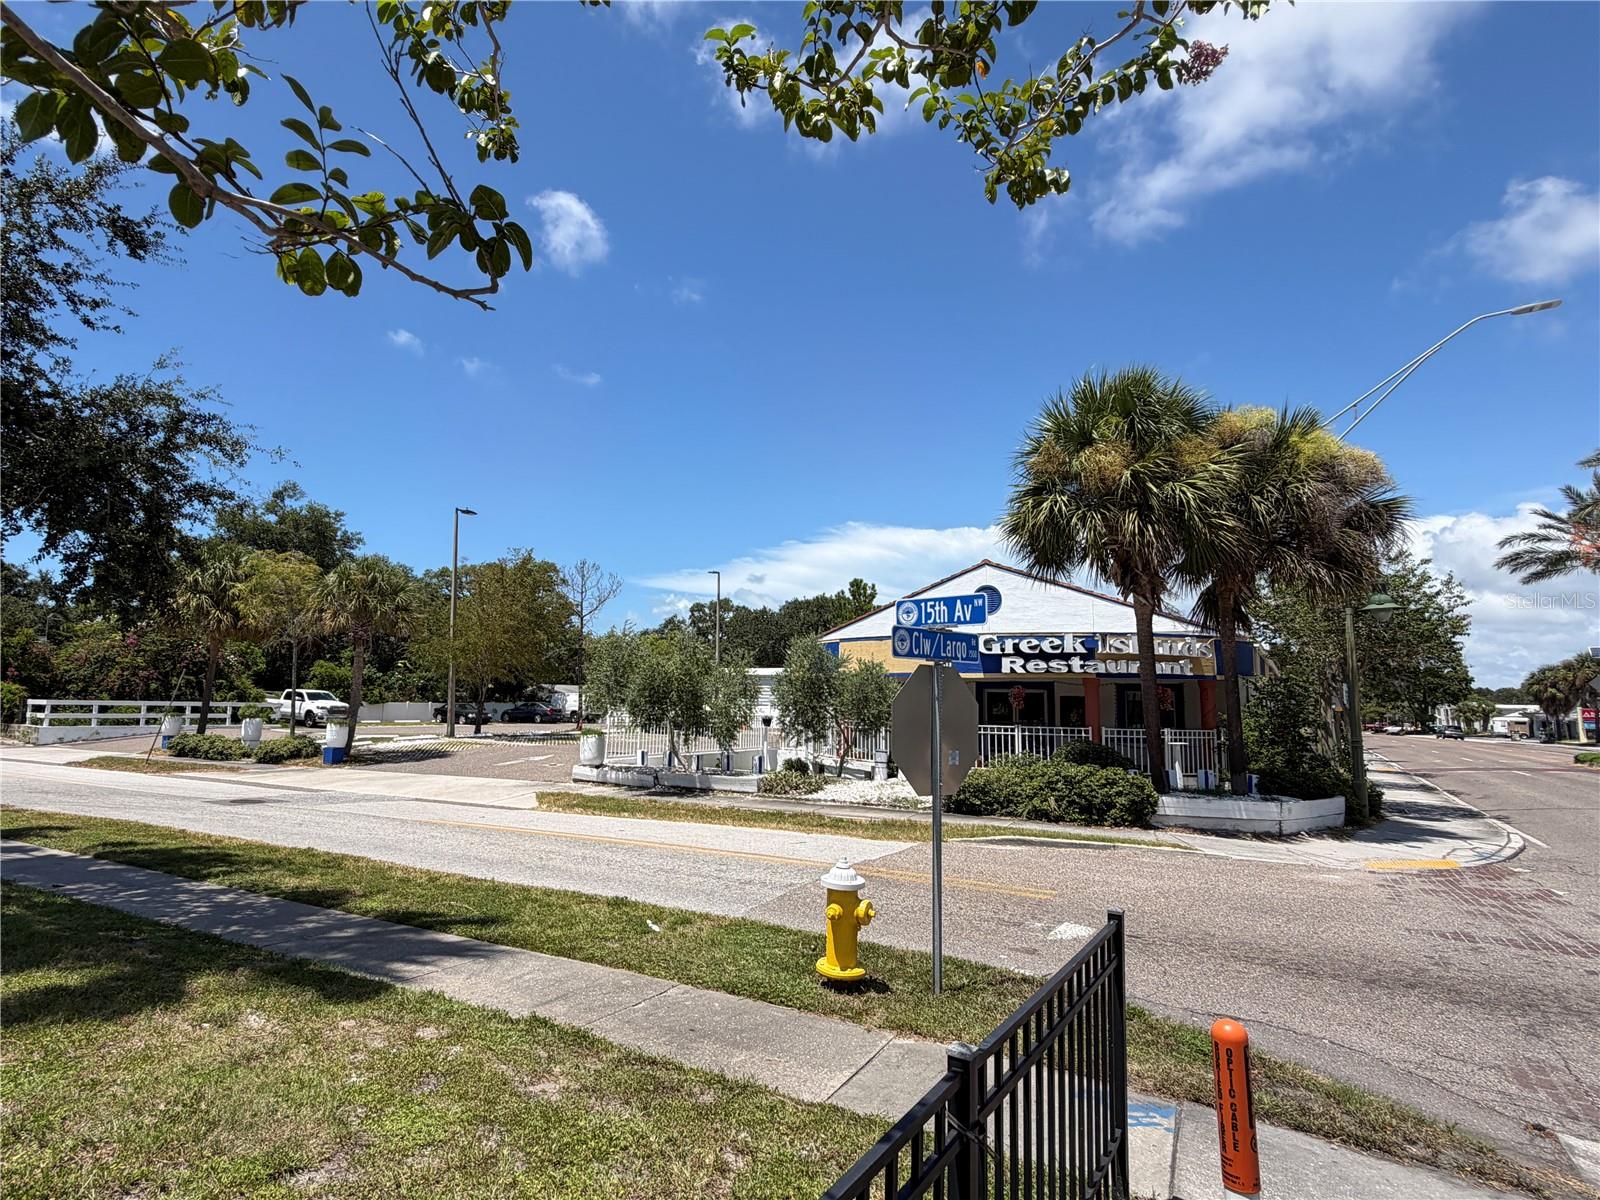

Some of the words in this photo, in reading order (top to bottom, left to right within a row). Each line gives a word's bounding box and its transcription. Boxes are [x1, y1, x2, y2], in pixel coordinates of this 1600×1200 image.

[920, 600, 948, 624] 15th
[954, 599, 972, 622] Av
[912, 631, 967, 661] Clw/Largo
[979, 633, 1088, 654] Greek
[1092, 633, 1213, 659] Islnds
[1001, 655, 1194, 676] Restaurnt
[1226, 1048, 1235, 1099] OPTIC
[1230, 1102, 1240, 1152] CABLE
